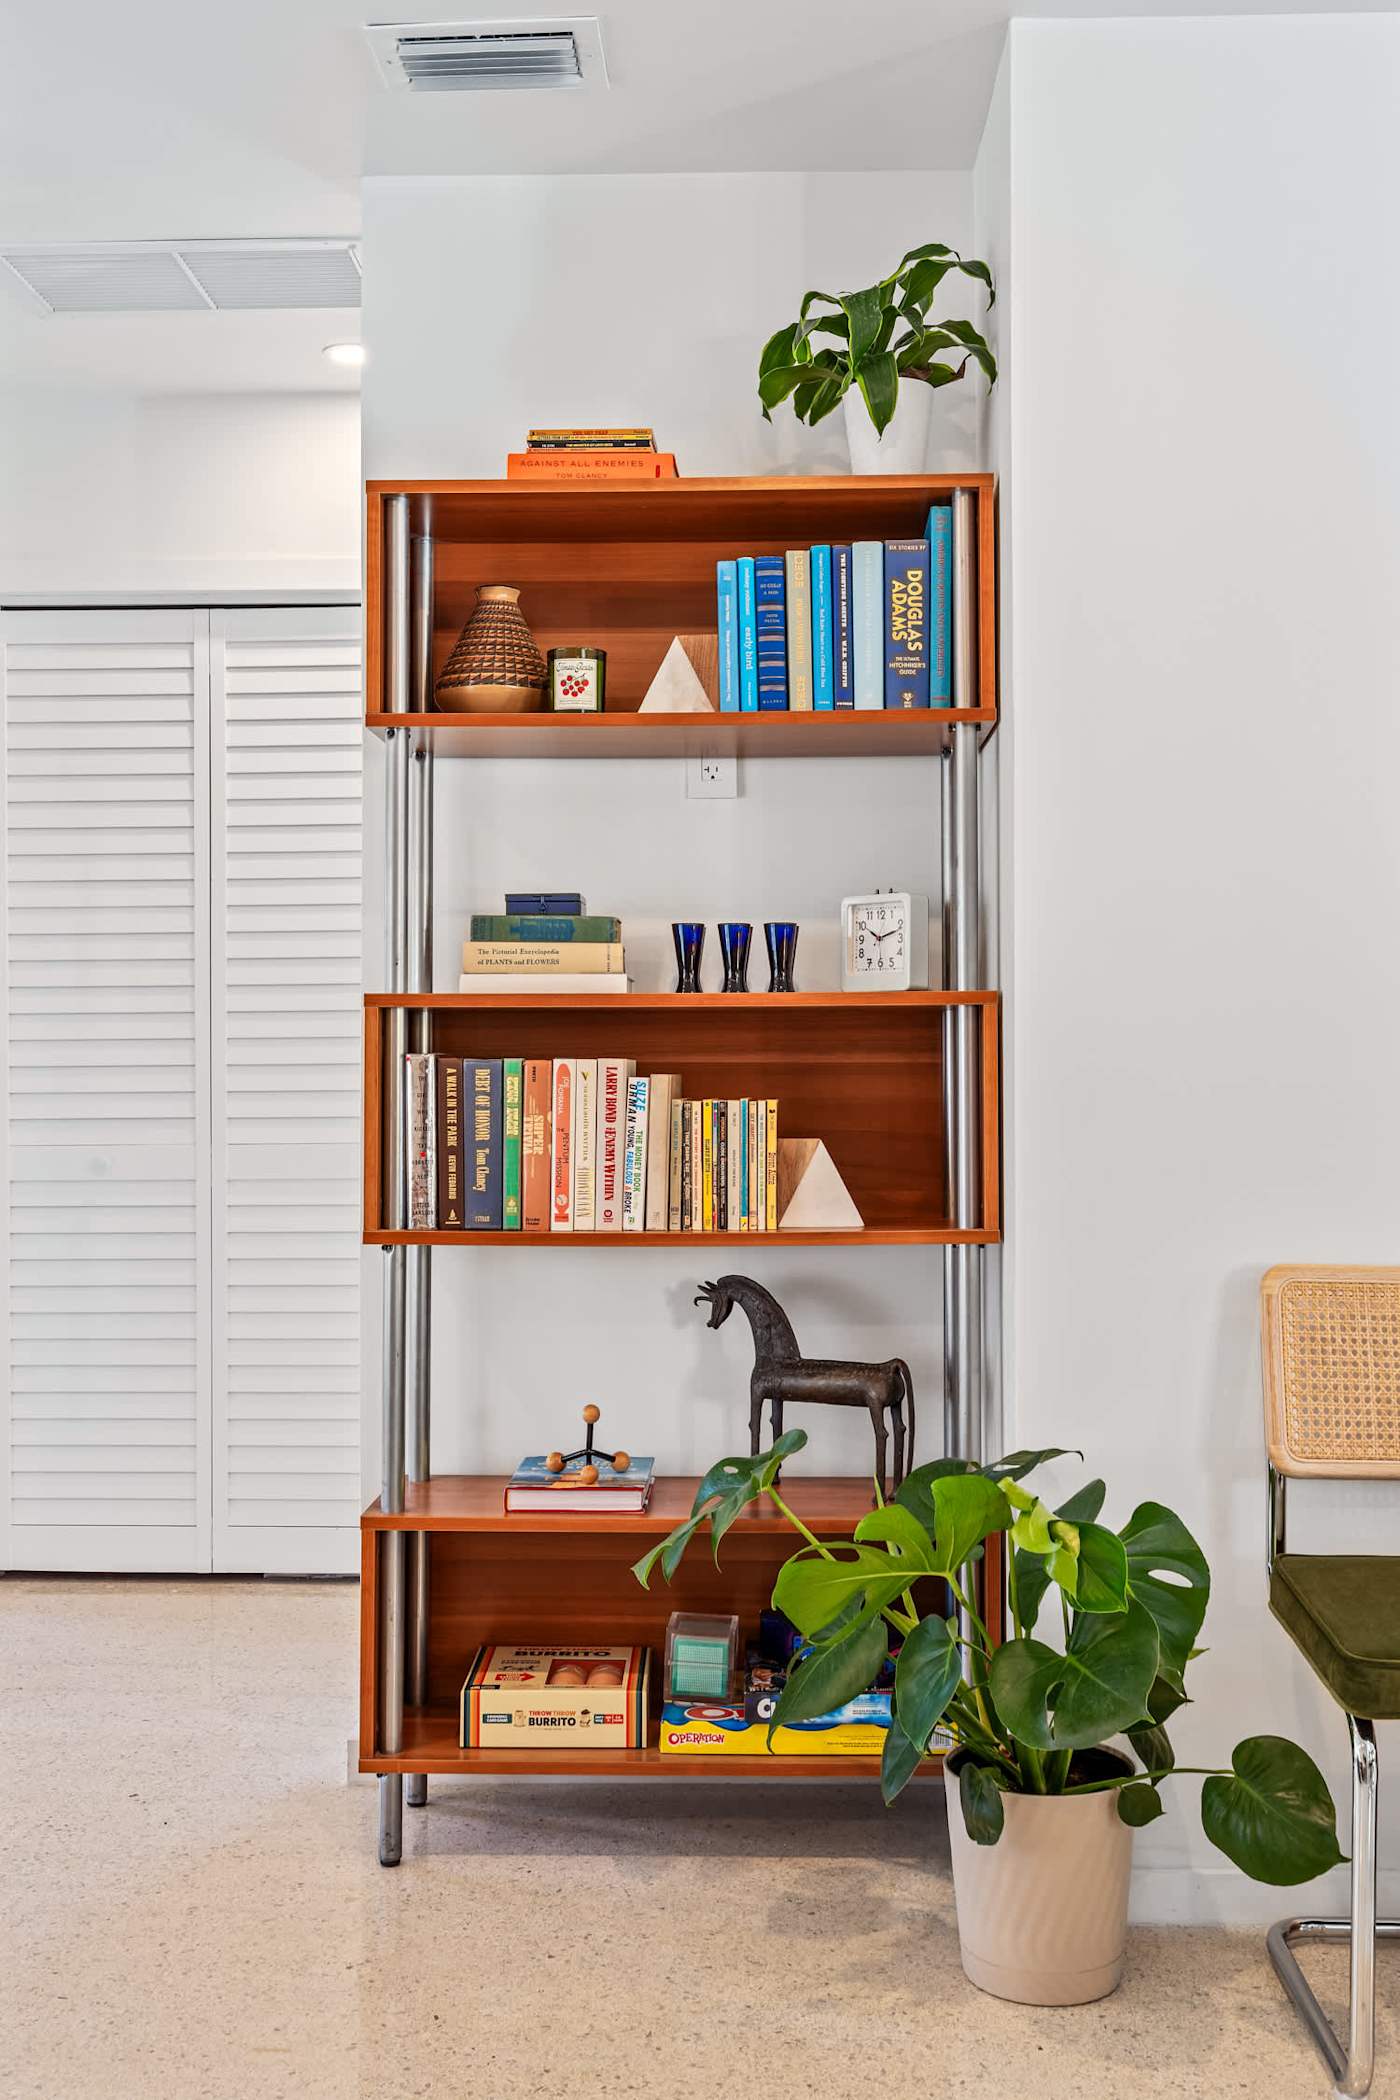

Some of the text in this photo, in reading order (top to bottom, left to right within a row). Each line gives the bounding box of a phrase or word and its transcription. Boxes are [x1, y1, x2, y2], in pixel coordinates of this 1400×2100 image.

[520, 460, 644, 468] AGAINST ALL ENEMIES
[891, 580, 908, 642] ADAMS
[906, 570, 924, 652] DOUGLAS
[743, 627, 753, 670] early bird
[866, 911, 872, 920] 11
[876, 910, 886, 920] 12
[898, 919, 904, 930] 2
[858, 921, 866, 931] 10
[858, 935, 864, 944] 9
[898, 933, 904, 943] 3
[520, 948, 560, 956] Encyclopedia
[858, 948, 864, 958] 8
[896, 947, 902, 956] 4
[866, 958, 872, 968] 7
[877, 958, 884, 968] 6
[888, 958, 894, 968] 5
[446, 1075, 456, 1097] WALK
[605, 1066, 618, 1123] LARRY BOND
[635, 1080, 646, 1112] SUZE
[446, 1098, 457, 1106] IN
[475, 1068, 490, 1141] DEBT OF HONOR
[628, 1084, 638, 1123] ORMAN
[446, 1109, 457, 1124] THE
[447, 1126, 458, 1147] PARK
[524, 1116, 534, 1154] TRIVIA
[533, 1114, 544, 1155] SUPER
[626, 1125, 636, 1150] YOUNG,
[635, 1131, 644, 1145] THE
[605, 1131, 616, 1163] ENEMY
[625, 1151, 634, 1185] FABULOUS
[634, 1146, 643, 1171] MONEY
[448, 1155, 457, 1200] KEVIN FEDARKO
[472, 1148, 490, 1192] Tom Clancy
[604, 1164, 616, 1200] WITHIN
[633, 1172, 642, 1192] BOOK
[624, 1191, 632, 1214] BROKE
[528, 1717, 576, 1726] BURRITO
[668, 1732, 724, 1745] OPERATION
